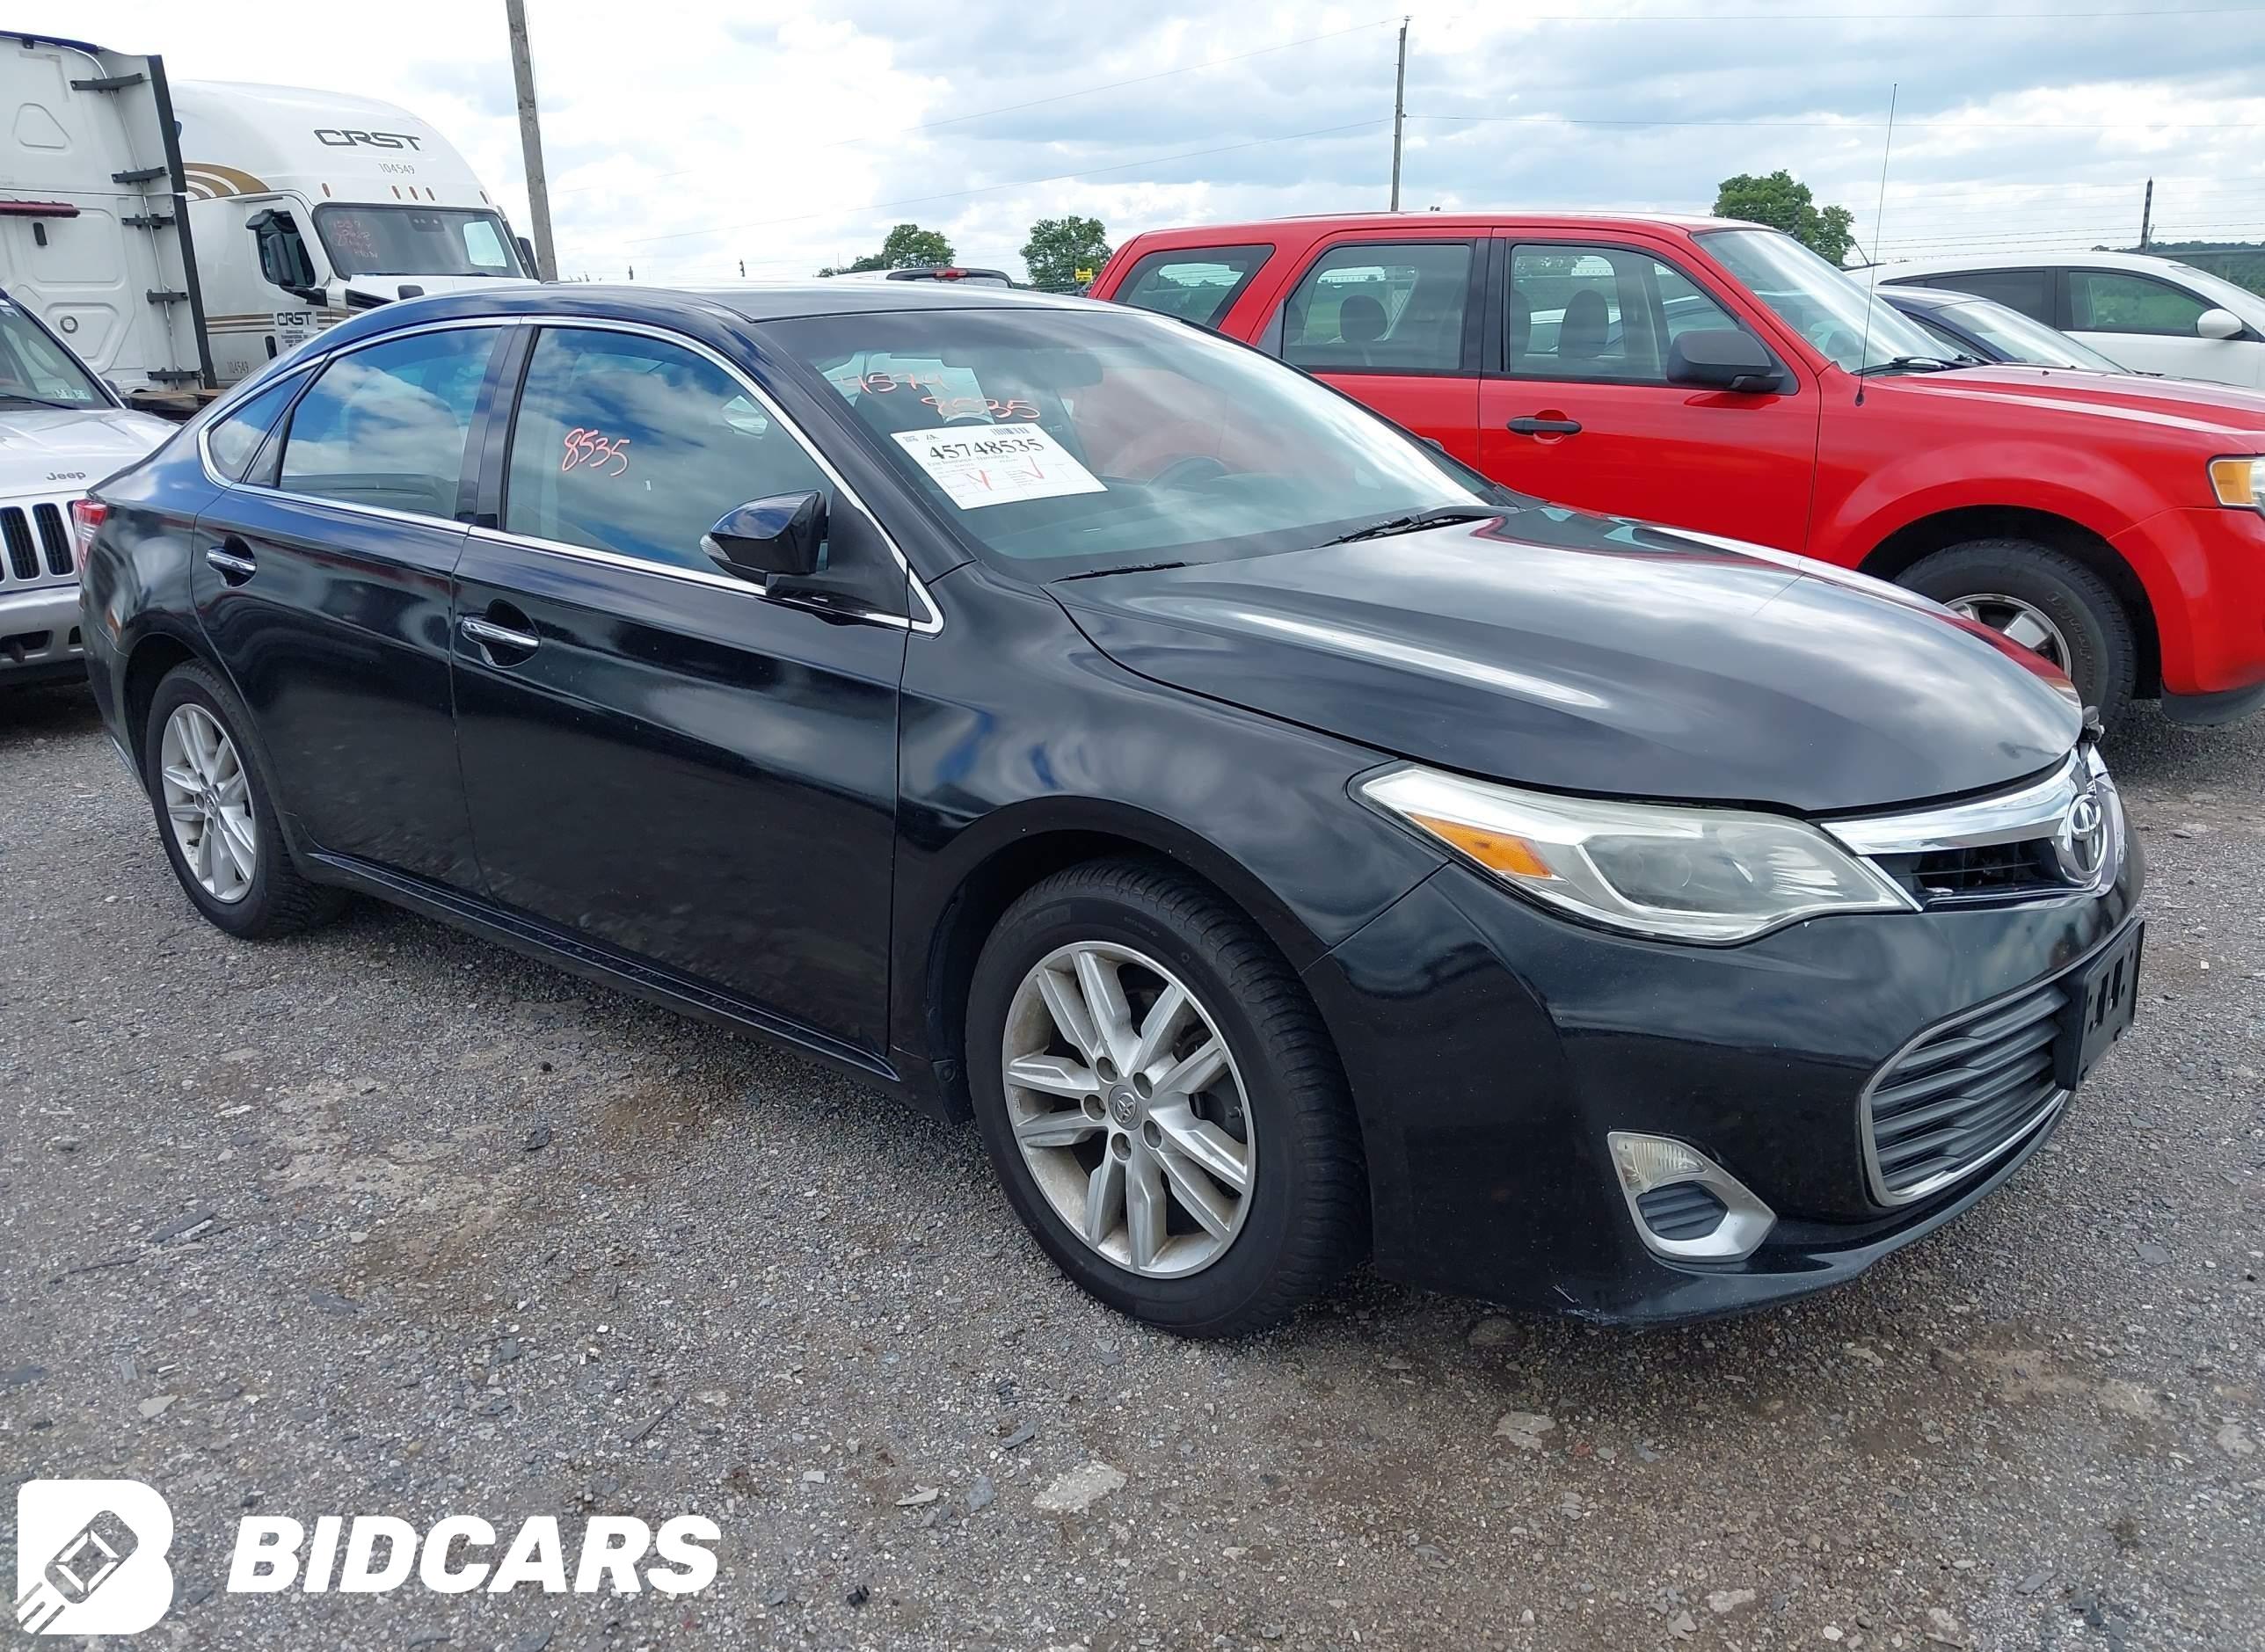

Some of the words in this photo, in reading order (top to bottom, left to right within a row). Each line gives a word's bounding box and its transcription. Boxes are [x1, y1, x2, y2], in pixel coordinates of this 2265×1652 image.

[314, 129, 421, 151] CRST
[378, 163, 415, 175] 104549
[277, 311, 312, 325] CRST
[563, 427, 630, 477] 8535
[929, 438, 1044, 460] 45748535
[46, 471, 86, 481] Jeep
